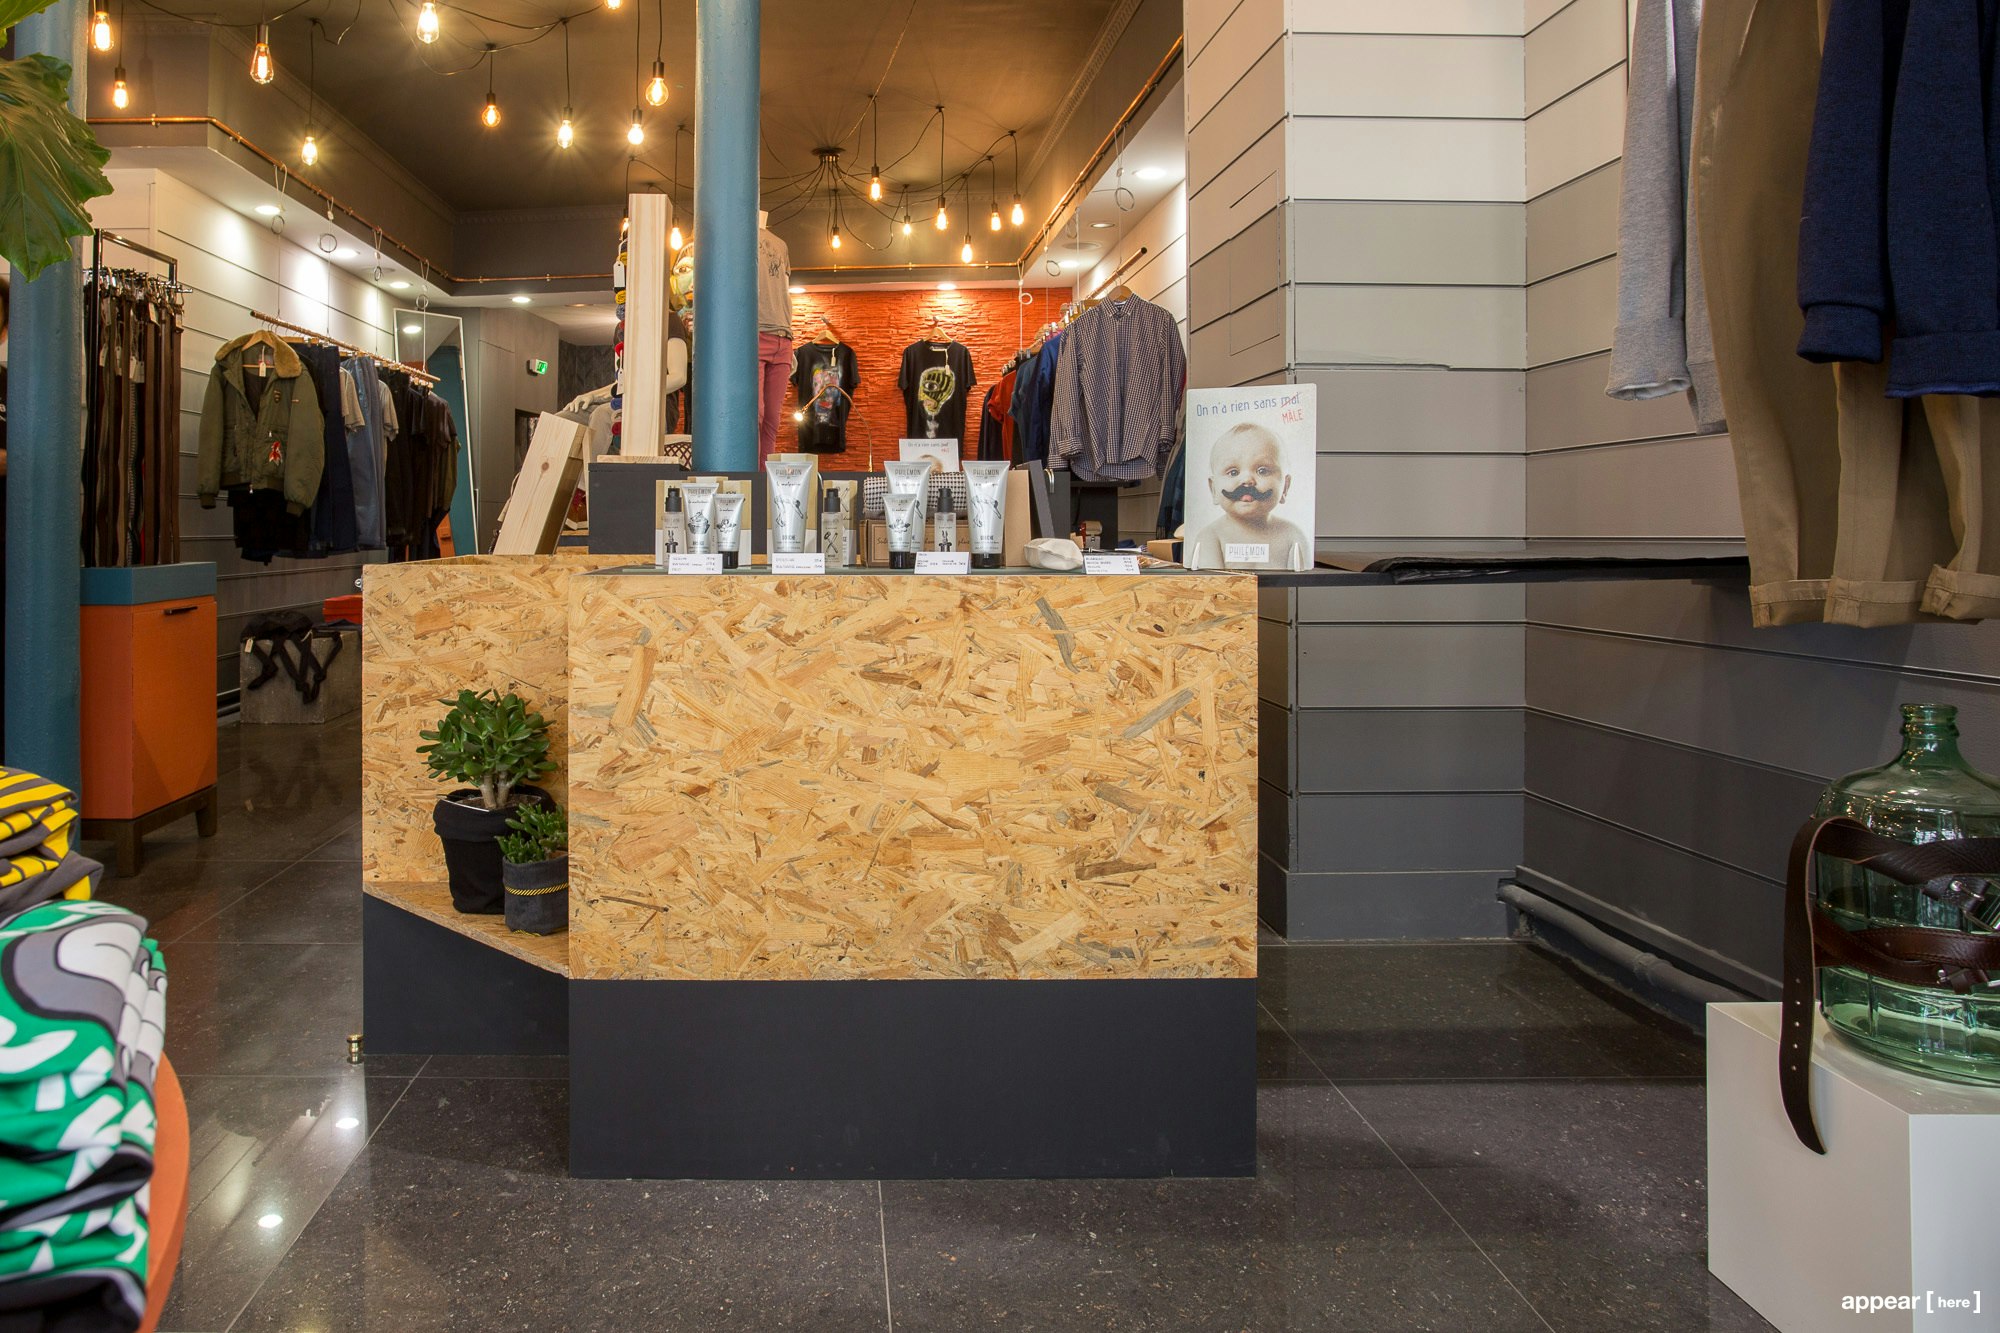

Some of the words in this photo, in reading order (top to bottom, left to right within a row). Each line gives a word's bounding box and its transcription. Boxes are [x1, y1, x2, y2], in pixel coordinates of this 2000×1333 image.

[1196, 404, 1209, 417] On
[1212, 402, 1227, 415] n'a
[1231, 399, 1250, 413] rien
[1254, 397, 1277, 411] sans
